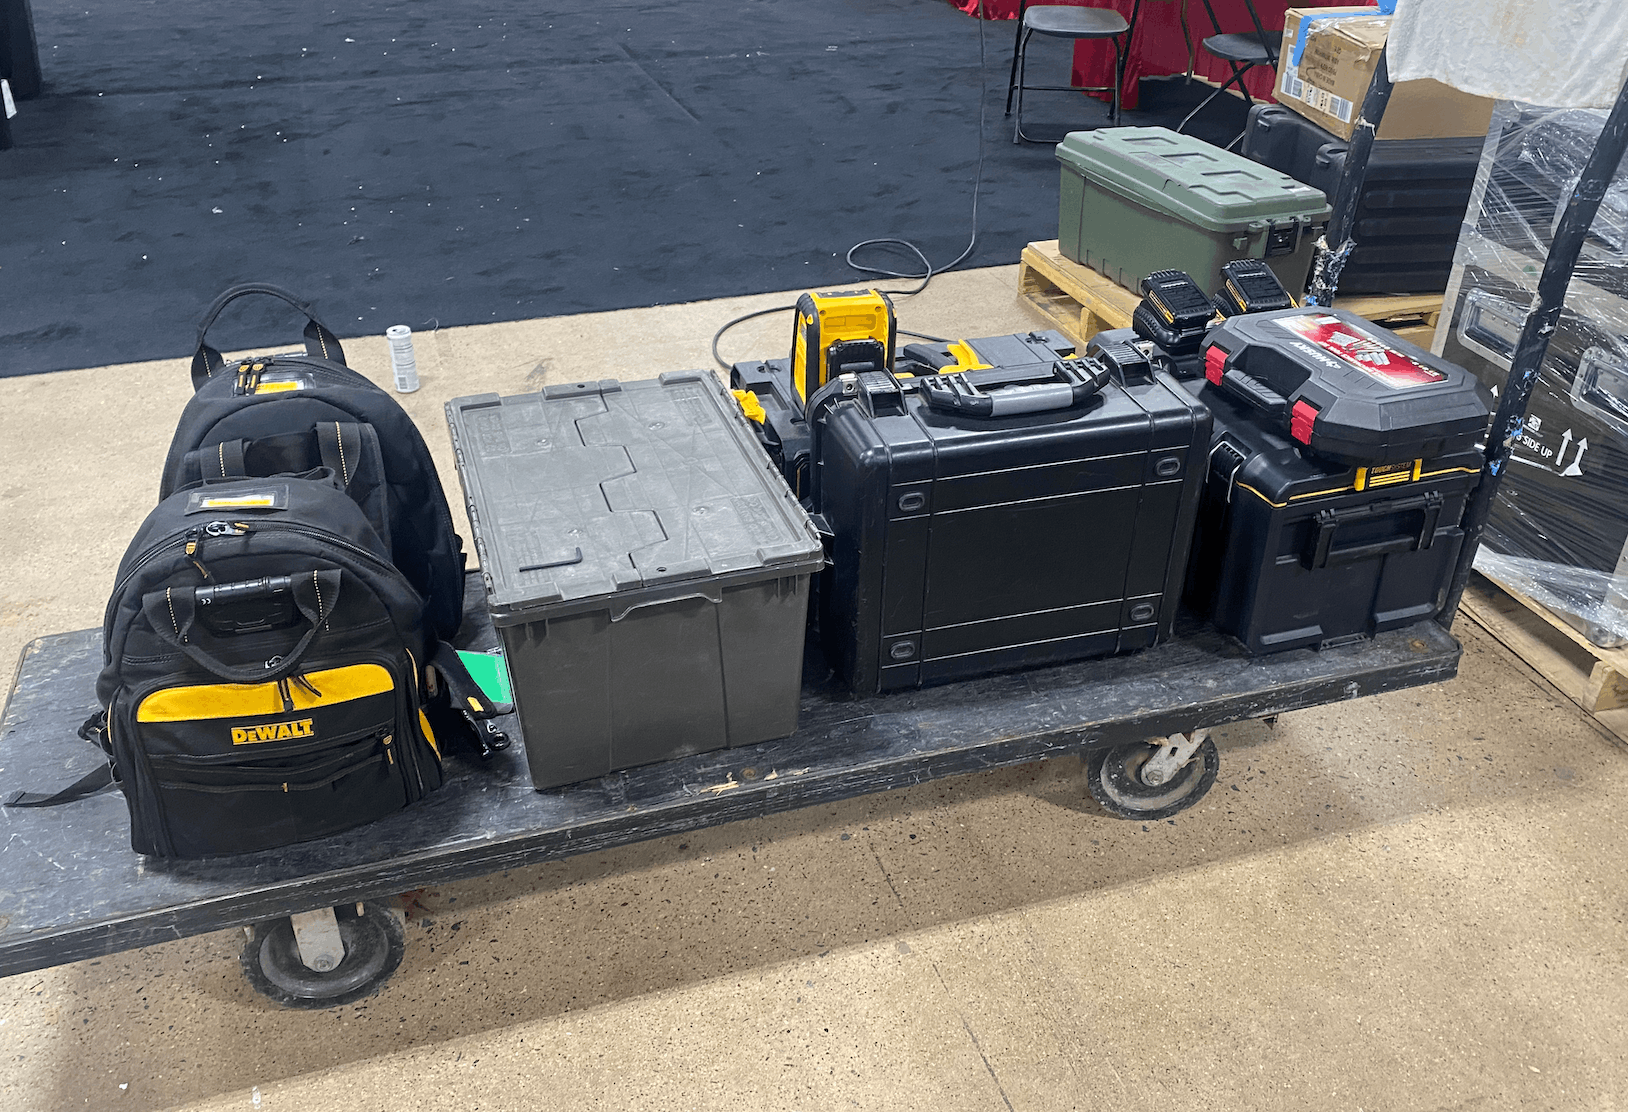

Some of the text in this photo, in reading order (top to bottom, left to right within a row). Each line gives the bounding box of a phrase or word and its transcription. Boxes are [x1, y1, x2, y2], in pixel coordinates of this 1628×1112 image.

[1289, 341, 1329, 361] HUSKY
[1522, 435, 1541, 453] SIDE
[1540, 445, 1553, 459] UP
[232, 720, 313, 743] DEWALT
